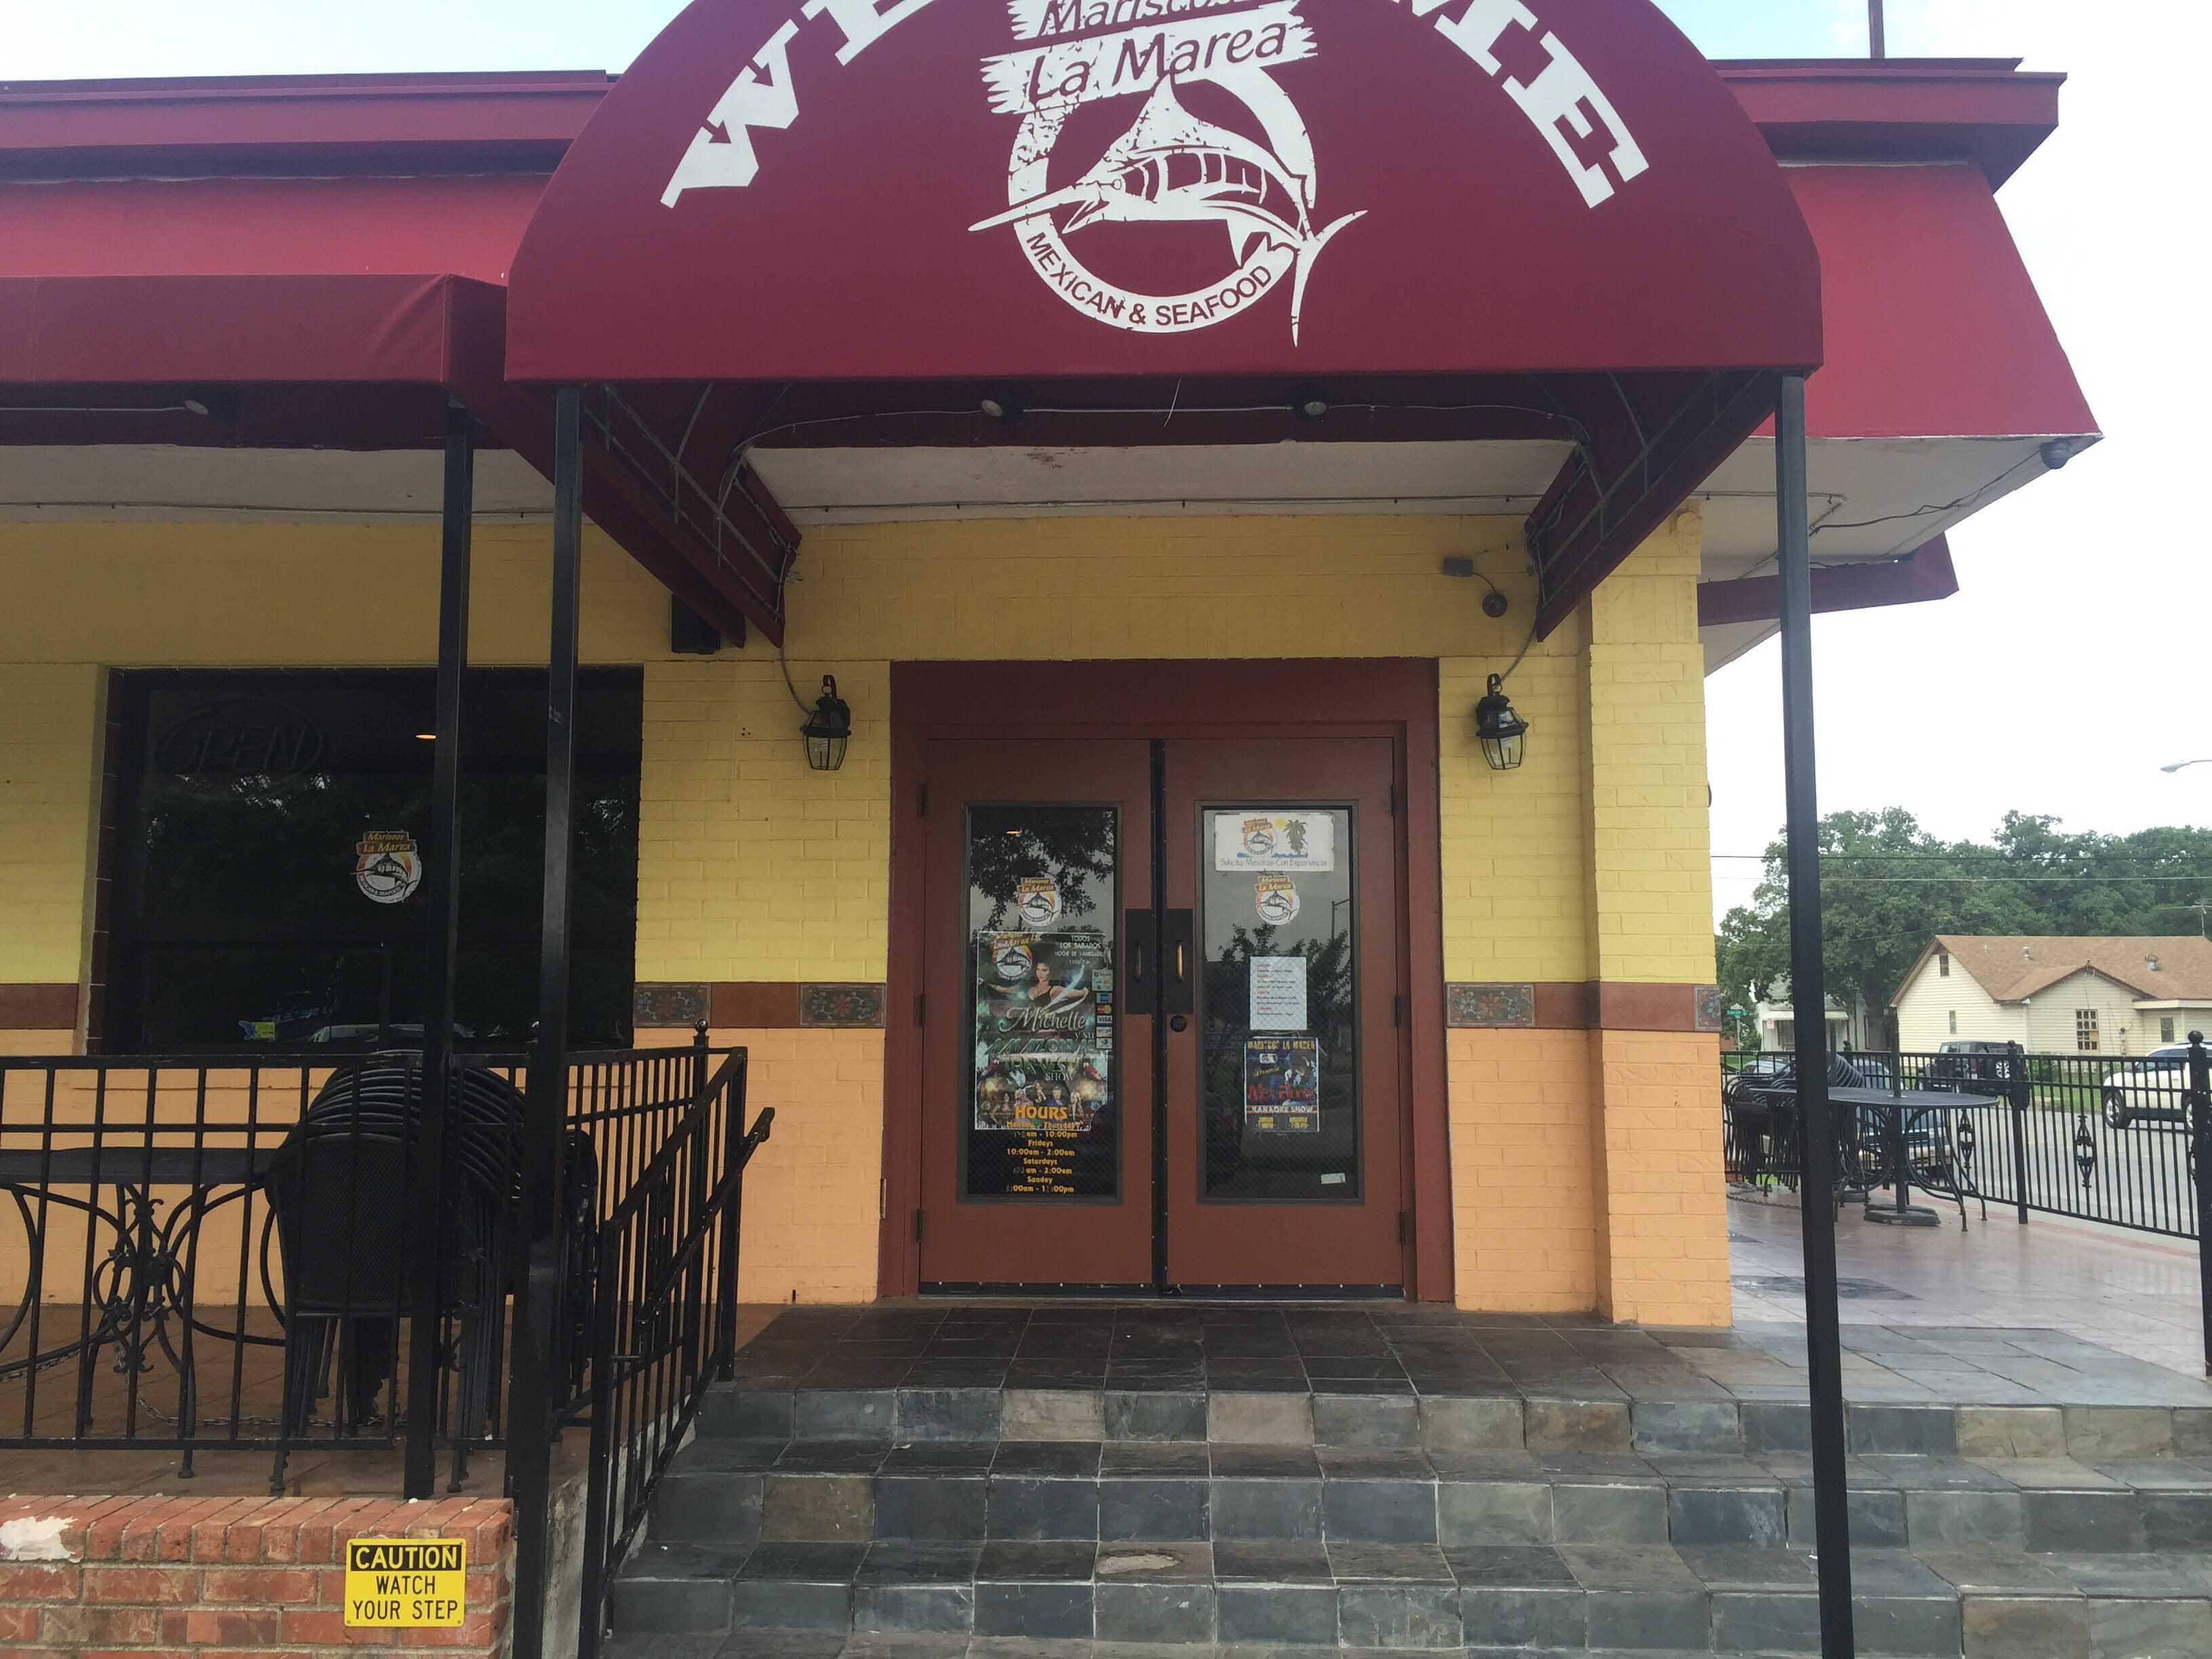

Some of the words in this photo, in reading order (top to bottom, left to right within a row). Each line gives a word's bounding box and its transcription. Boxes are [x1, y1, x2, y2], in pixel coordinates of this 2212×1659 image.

[1037, 0, 1232, 37] Marisc
[1028, 55, 1090, 102] La
[1112, 23, 1288, 87] Marea
[660, 0, 1650, 209] WEME
[1026, 232, 1125, 319] MEXICAN
[1128, 303, 1146, 325] &
[1155, 265, 1271, 326] SEAFOOD
[998, 1007, 1086, 1031] Michelle
[1045, 1073, 1075, 1081] SHOW
[1015, 1106, 1068, 1120] HOURS
[356, 1547, 457, 1569] CAUTION
[376, 1576, 436, 1595] WATCH
[353, 1600, 401, 1620] YOUR
[412, 1600, 458, 1620] STEP
